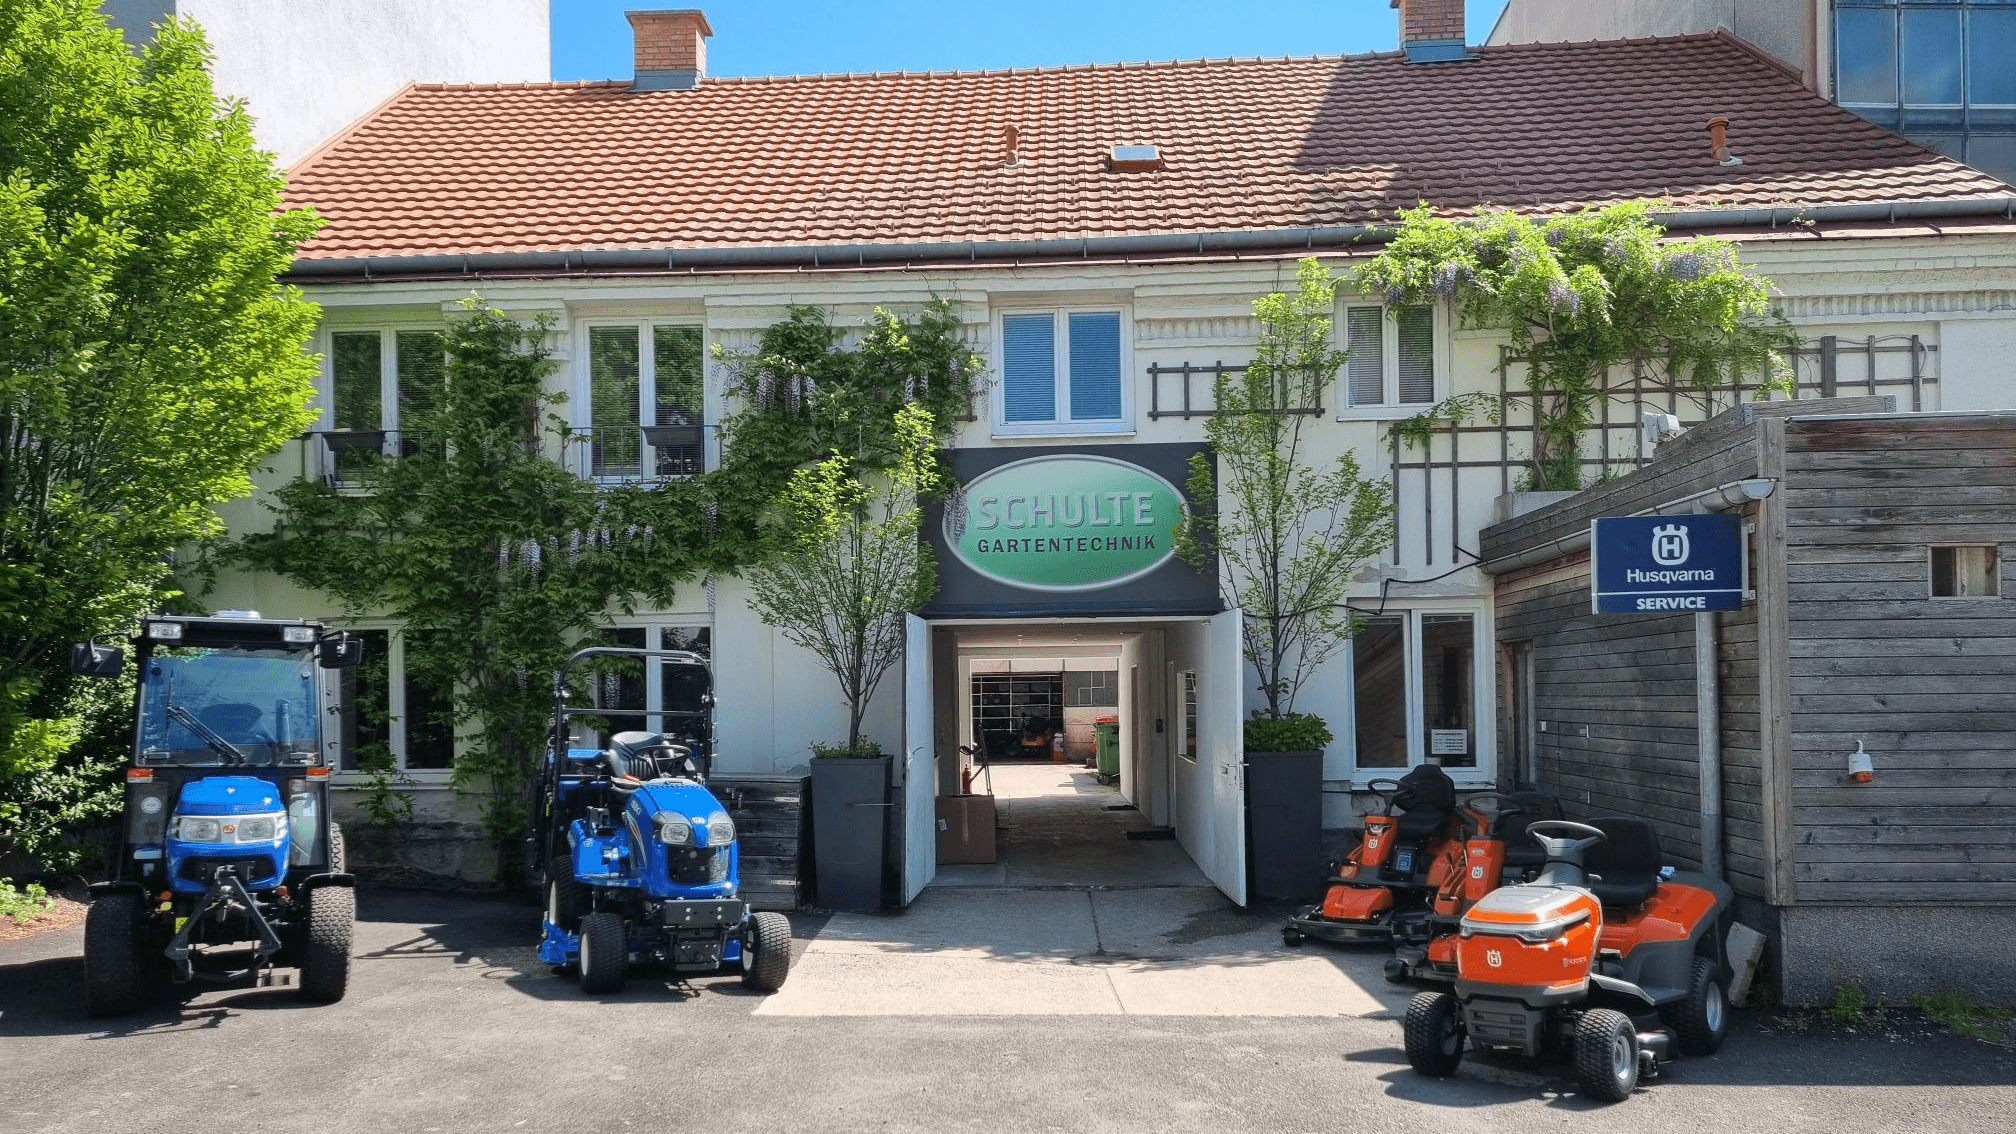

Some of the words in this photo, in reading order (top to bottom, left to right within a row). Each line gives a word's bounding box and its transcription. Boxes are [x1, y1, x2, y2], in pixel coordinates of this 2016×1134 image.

[976, 491, 1156, 529] SCHULTE
[977, 535, 1156, 553] GARTENTECHNIK
[1661, 537, 1680, 558] H
[1627, 569, 1714, 584] Husqvarna
[1636, 596, 1706, 610] SERVICE
